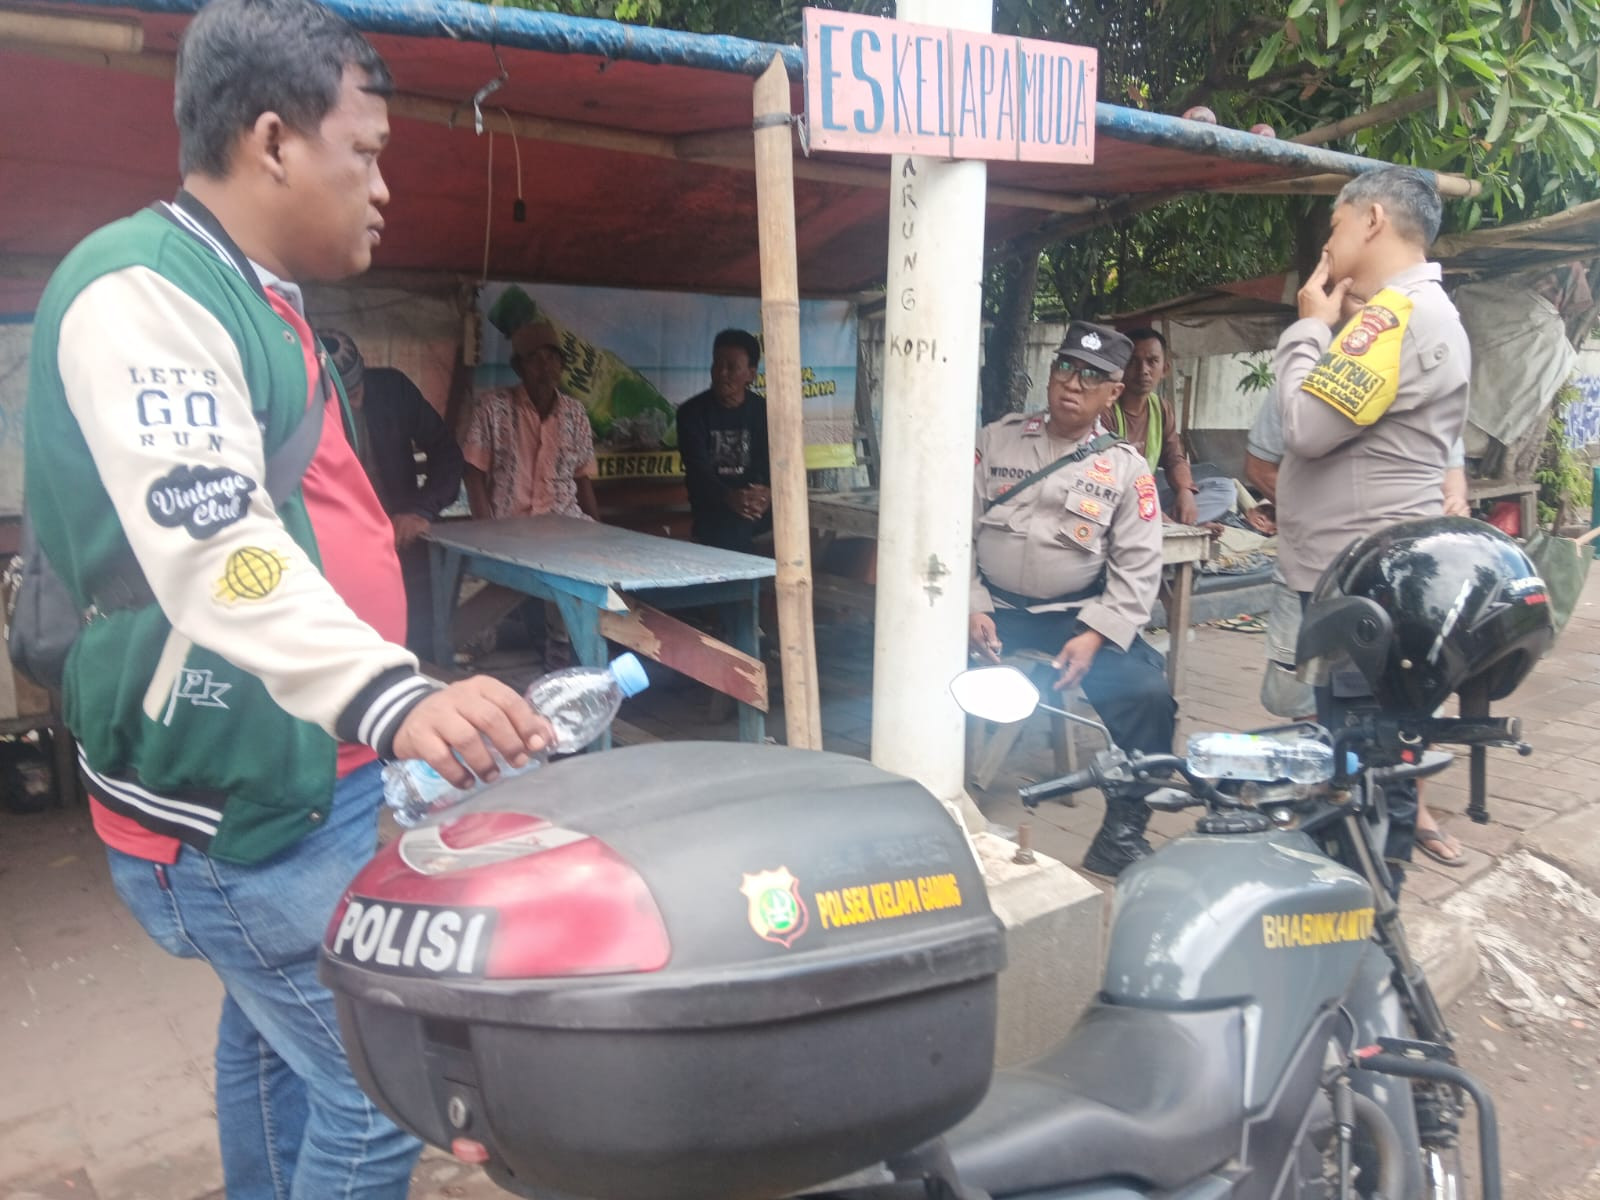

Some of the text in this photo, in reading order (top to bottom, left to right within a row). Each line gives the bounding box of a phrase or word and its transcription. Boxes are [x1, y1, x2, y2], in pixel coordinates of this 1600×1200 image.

[819, 24, 1088, 147] ES KELAPA MUDA
[128, 367, 218, 386] LET'S
[136, 388, 219, 429] GO
[141, 432, 224, 453] RUN
[597, 455, 673, 476] TERSEDIA
[990, 467, 1033, 480] WIDODO
[151, 475, 248, 515] Vintage
[1075, 479, 1120, 503] POLRI
[815, 886, 875, 930] POLSEK
[870, 879, 923, 919] KELAPA
[333, 902, 487, 974] POLISI
